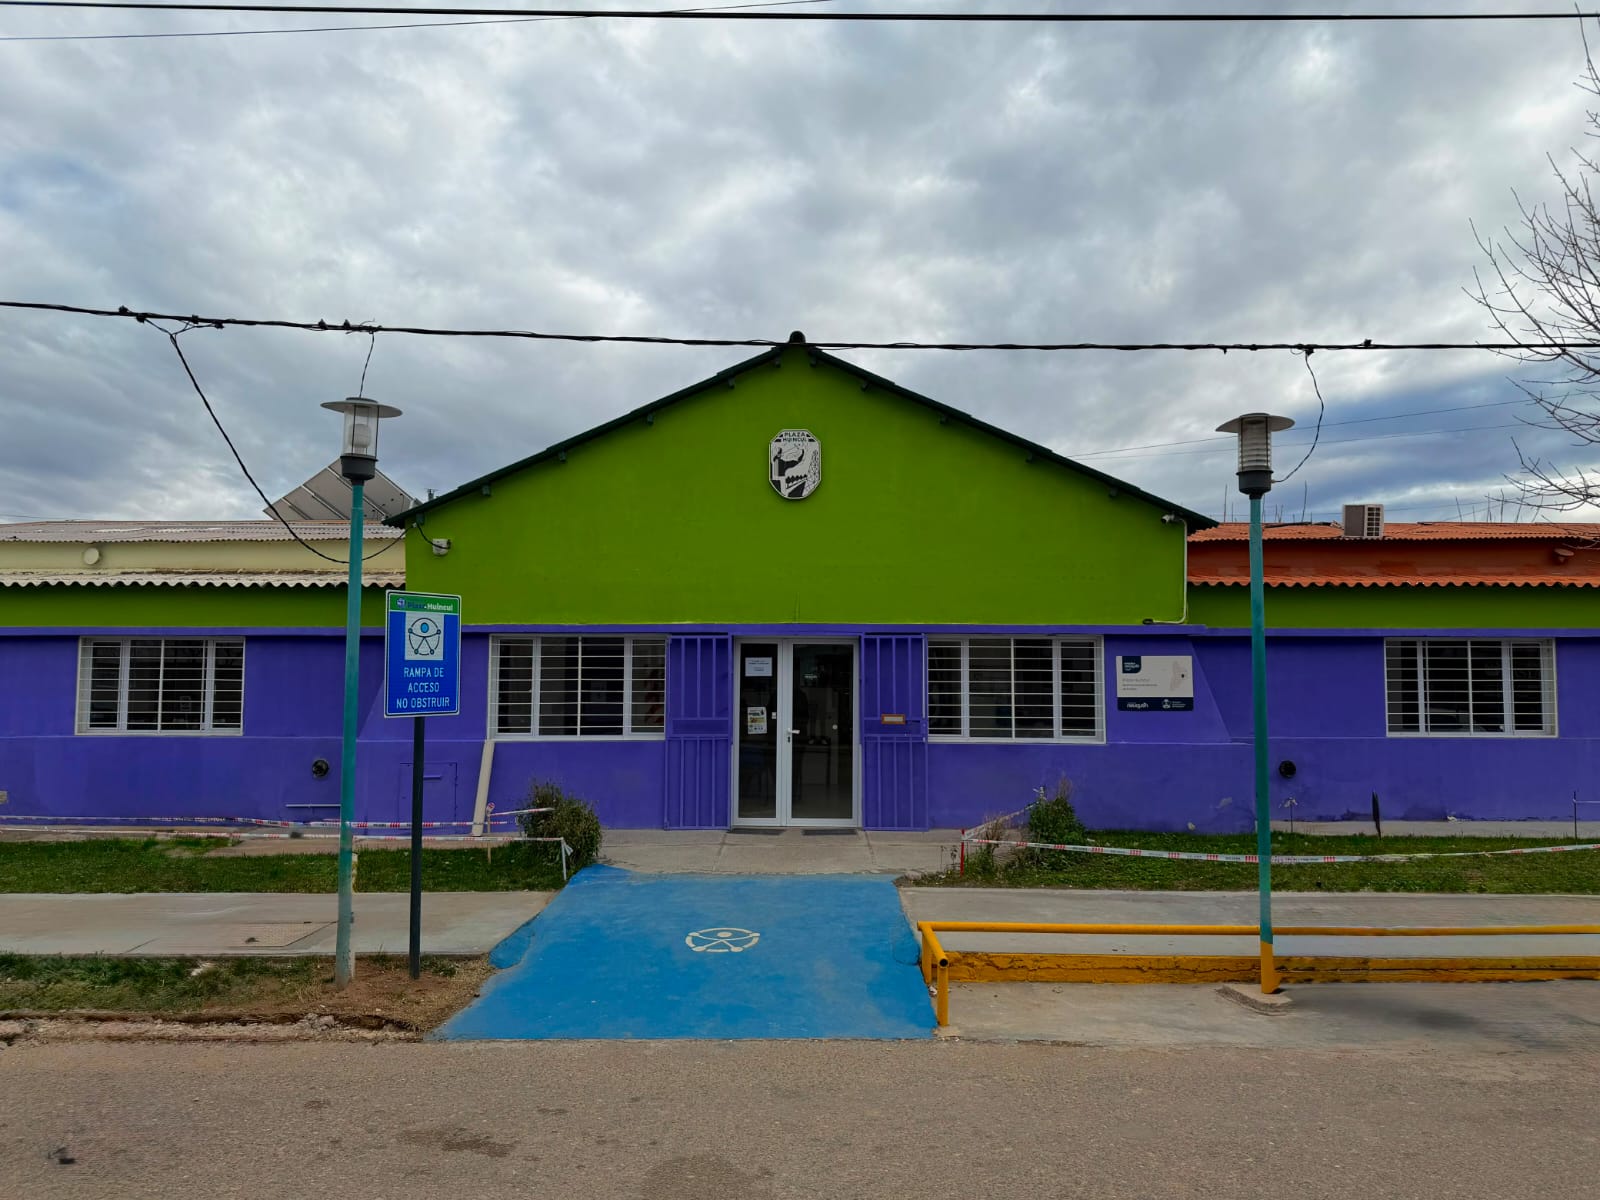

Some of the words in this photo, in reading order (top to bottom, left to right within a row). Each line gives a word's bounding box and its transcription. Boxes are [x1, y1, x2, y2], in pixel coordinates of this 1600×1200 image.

[403, 667, 432, 678] RAMPA
[434, 667, 445, 677] DE
[407, 682, 440, 693] ACCESO
[396, 698, 408, 709] NO
[410, 697, 450, 708] OBSTRUIR
